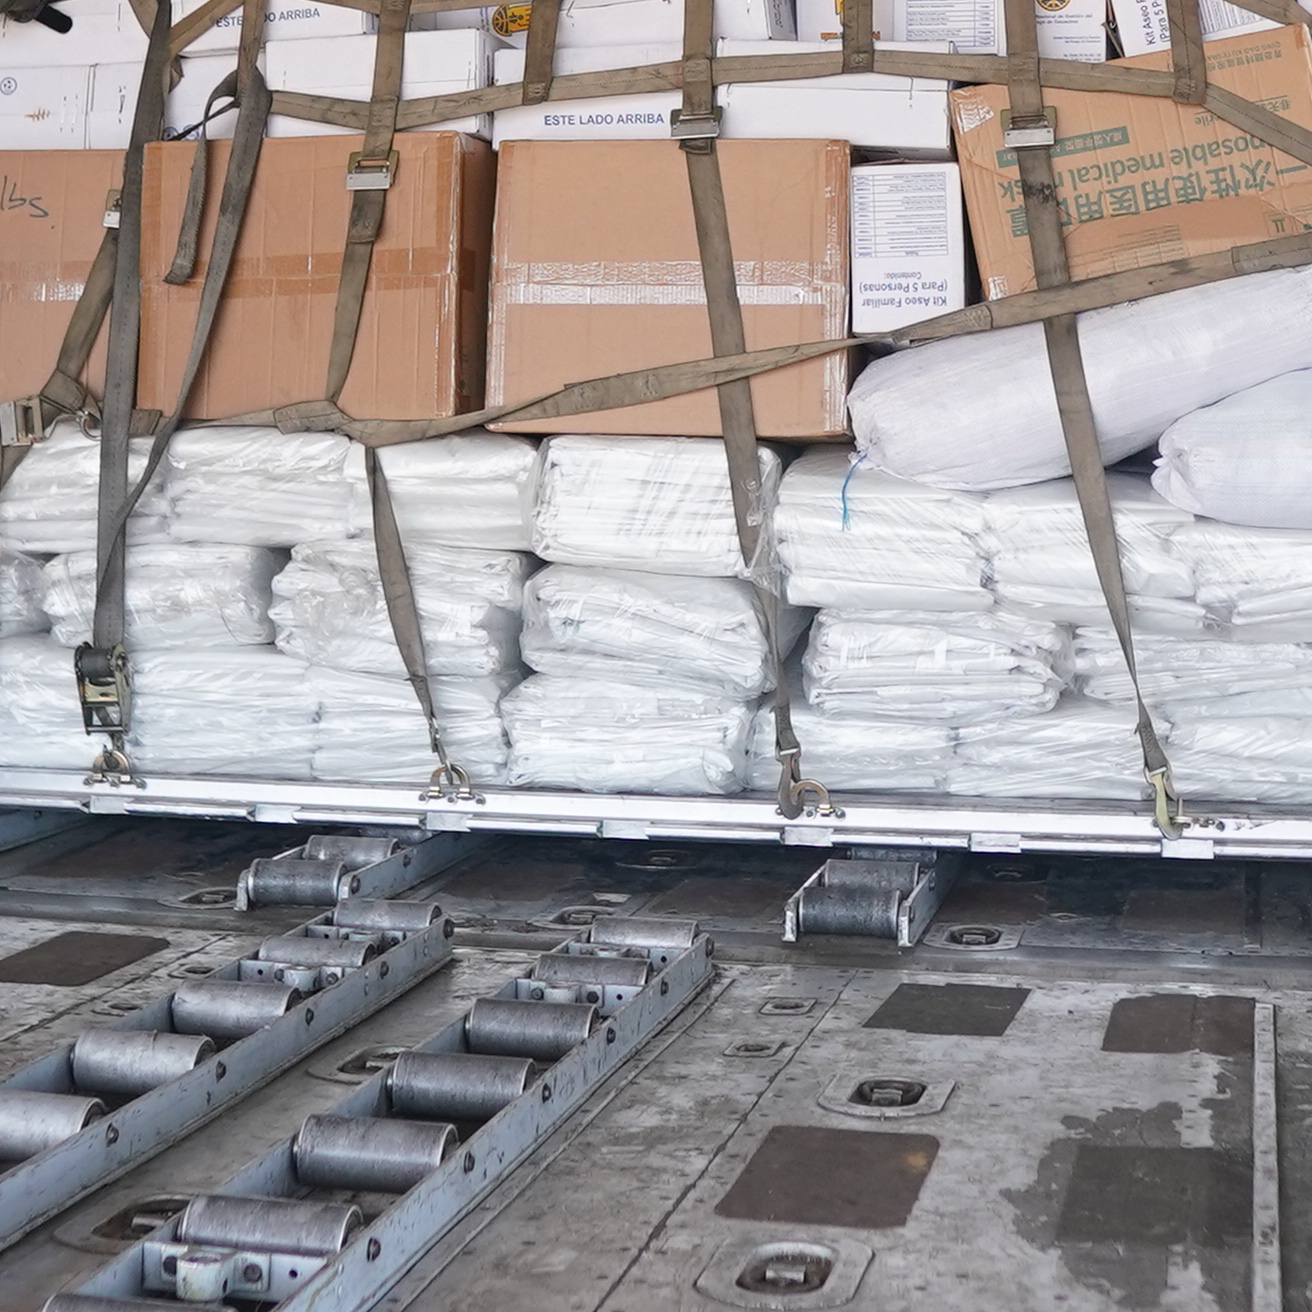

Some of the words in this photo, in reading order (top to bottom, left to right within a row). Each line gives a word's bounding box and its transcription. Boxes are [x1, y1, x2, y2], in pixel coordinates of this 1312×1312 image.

[216, 15, 244, 28] ESTE
[278, 7, 321, 21] ARRIBA
[1140, 5, 1153, 29] Aseo
[1154, 8, 1164, 16] 5
[1159, 17, 1172, 43] (Para
[1145, 30, 1156, 46] Kit
[544, 114, 576, 126] ESTE
[579, 113, 614, 125] LADO
[616, 112, 665, 125] ARRIBA
[1170, 135, 1267, 166] posable
[1068, 151, 1165, 186] medical
[883, 271, 923, 281] Contenido:
[859, 281, 910, 294] Personas)
[912, 282, 919, 293] 5
[921, 278, 948, 293] (Para
[861, 297, 902, 309] Familiar
[905, 296, 931, 307] Aseo
[933, 296, 947, 307] Kit
